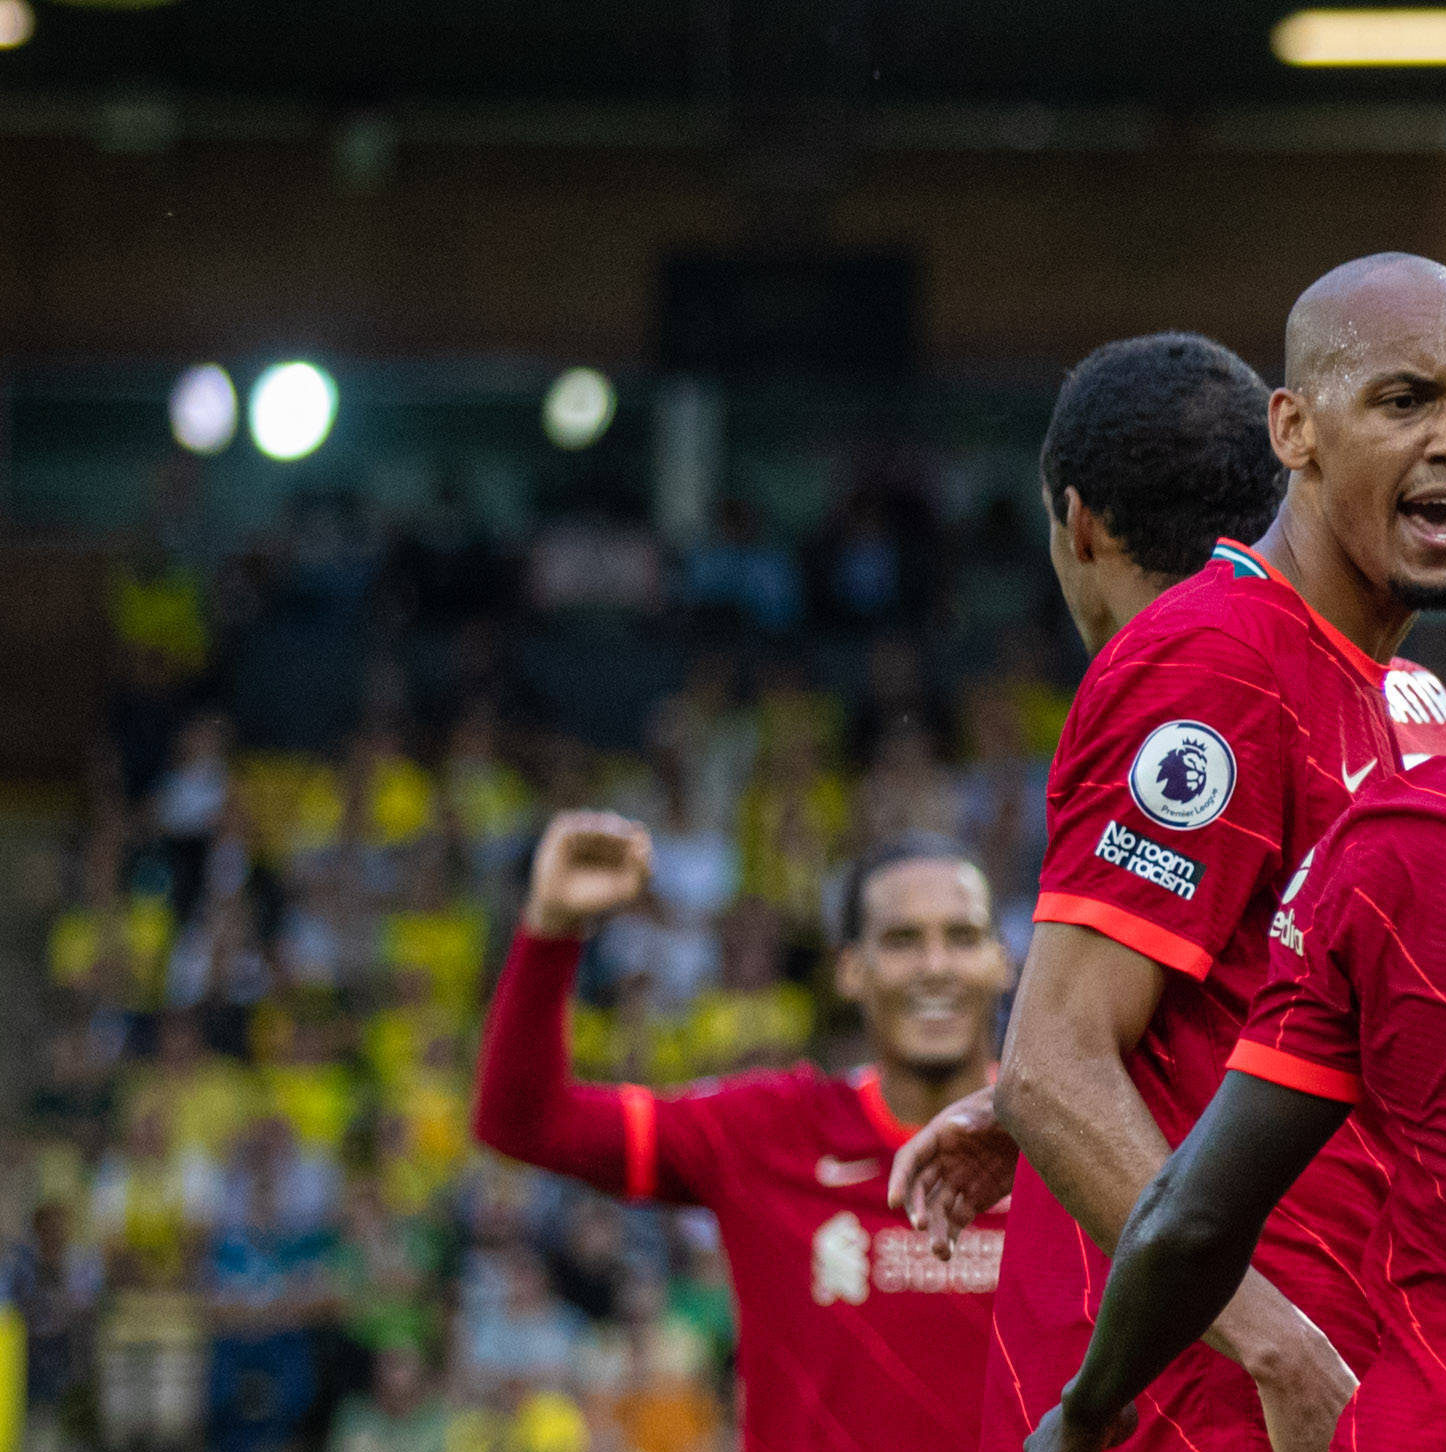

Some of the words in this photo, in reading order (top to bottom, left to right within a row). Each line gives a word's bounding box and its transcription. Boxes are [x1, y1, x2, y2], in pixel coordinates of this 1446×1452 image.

[1094, 839, 1131, 866] for
[1126, 855, 1197, 901] racism
[1100, 819, 1136, 850] No
[1136, 838, 1195, 880] room
